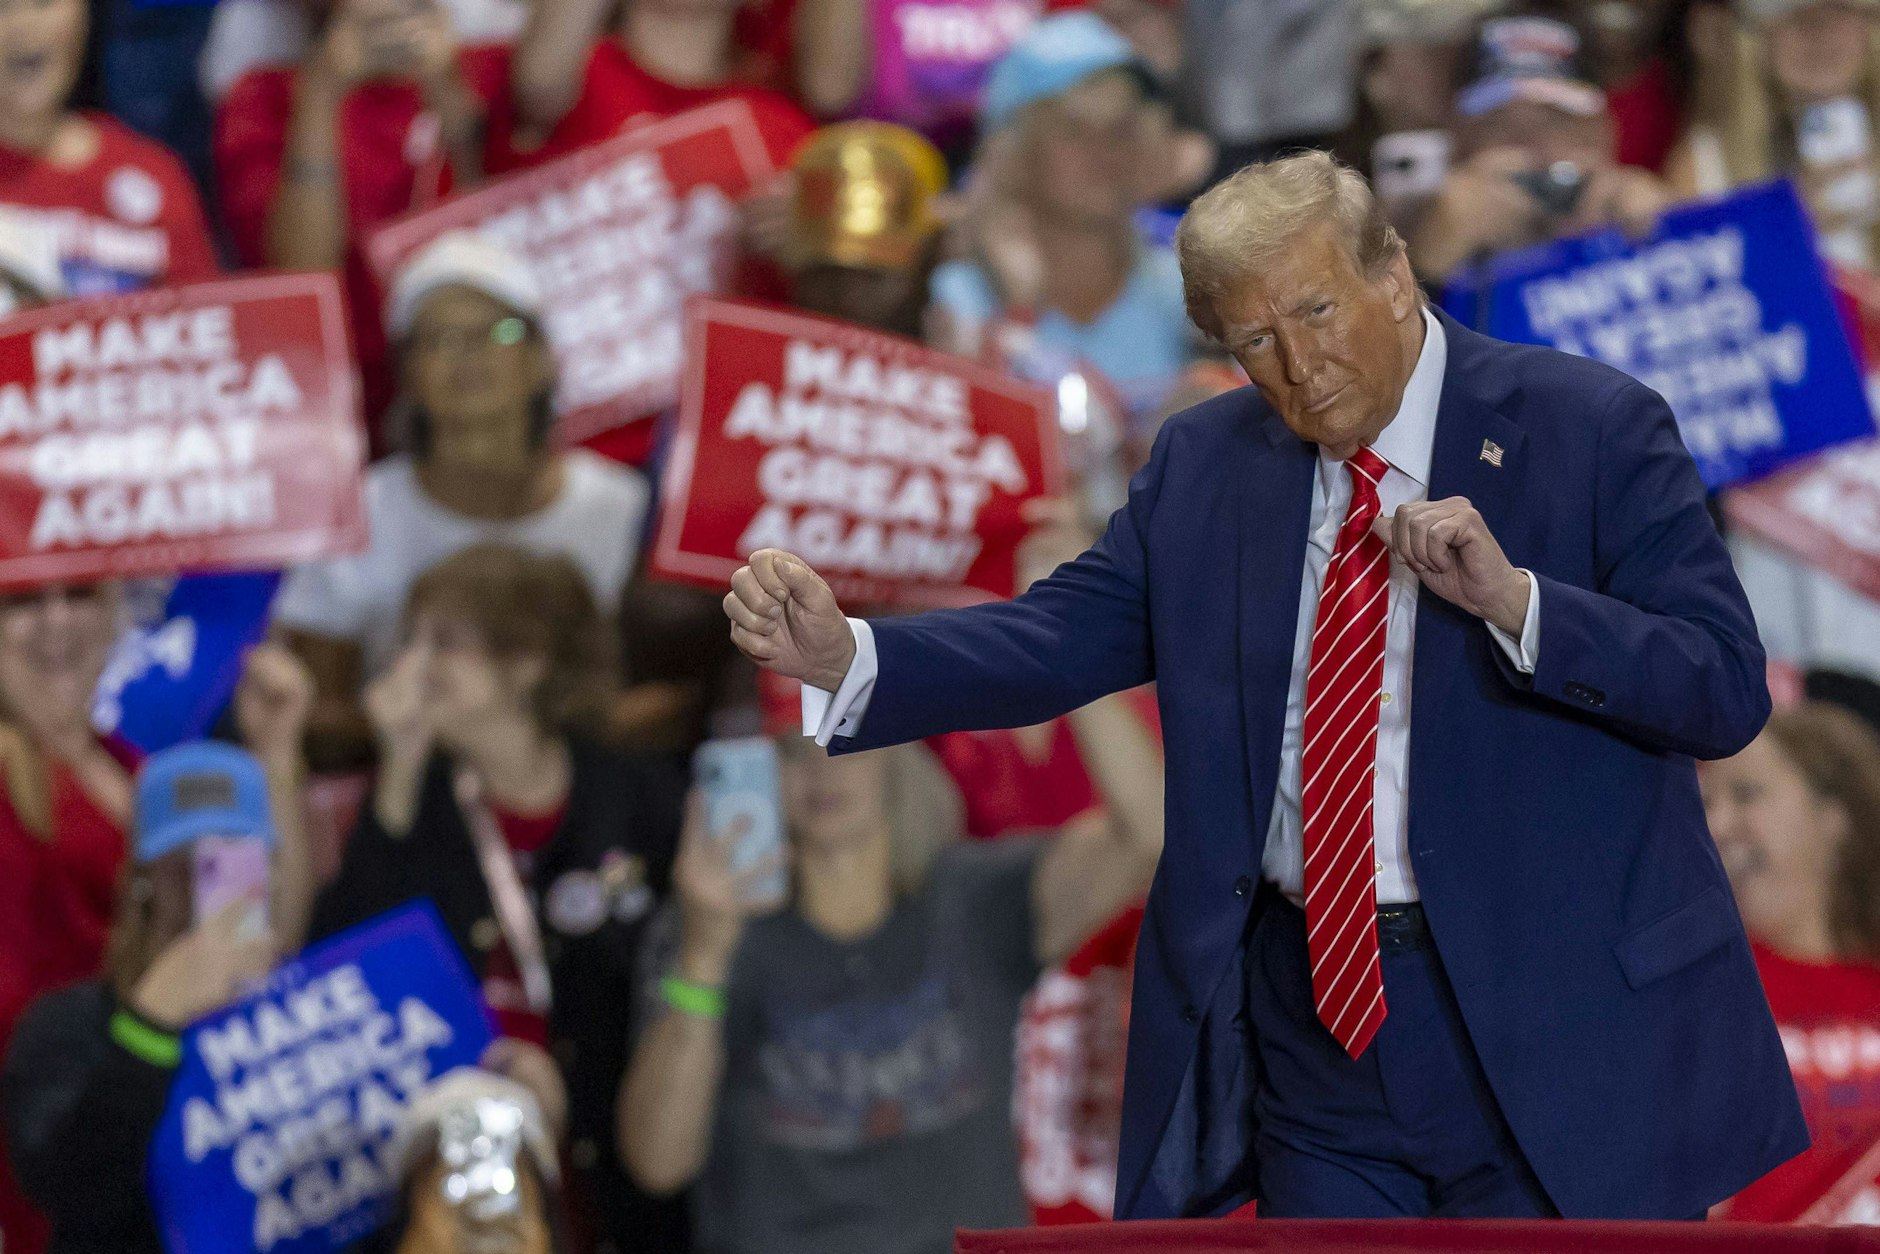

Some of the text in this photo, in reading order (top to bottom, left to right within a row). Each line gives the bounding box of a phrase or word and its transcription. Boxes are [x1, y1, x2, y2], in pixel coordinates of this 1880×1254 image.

[33, 305, 238, 374] MAKE
[784, 340, 974, 426] MAKE
[31, 418, 257, 488] GREAT
[722, 381, 1030, 497] AMERICA
[757, 447, 992, 532] GREAT
[197, 964, 379, 1082] MAKE
[182, 996, 453, 1163] AMERICA
